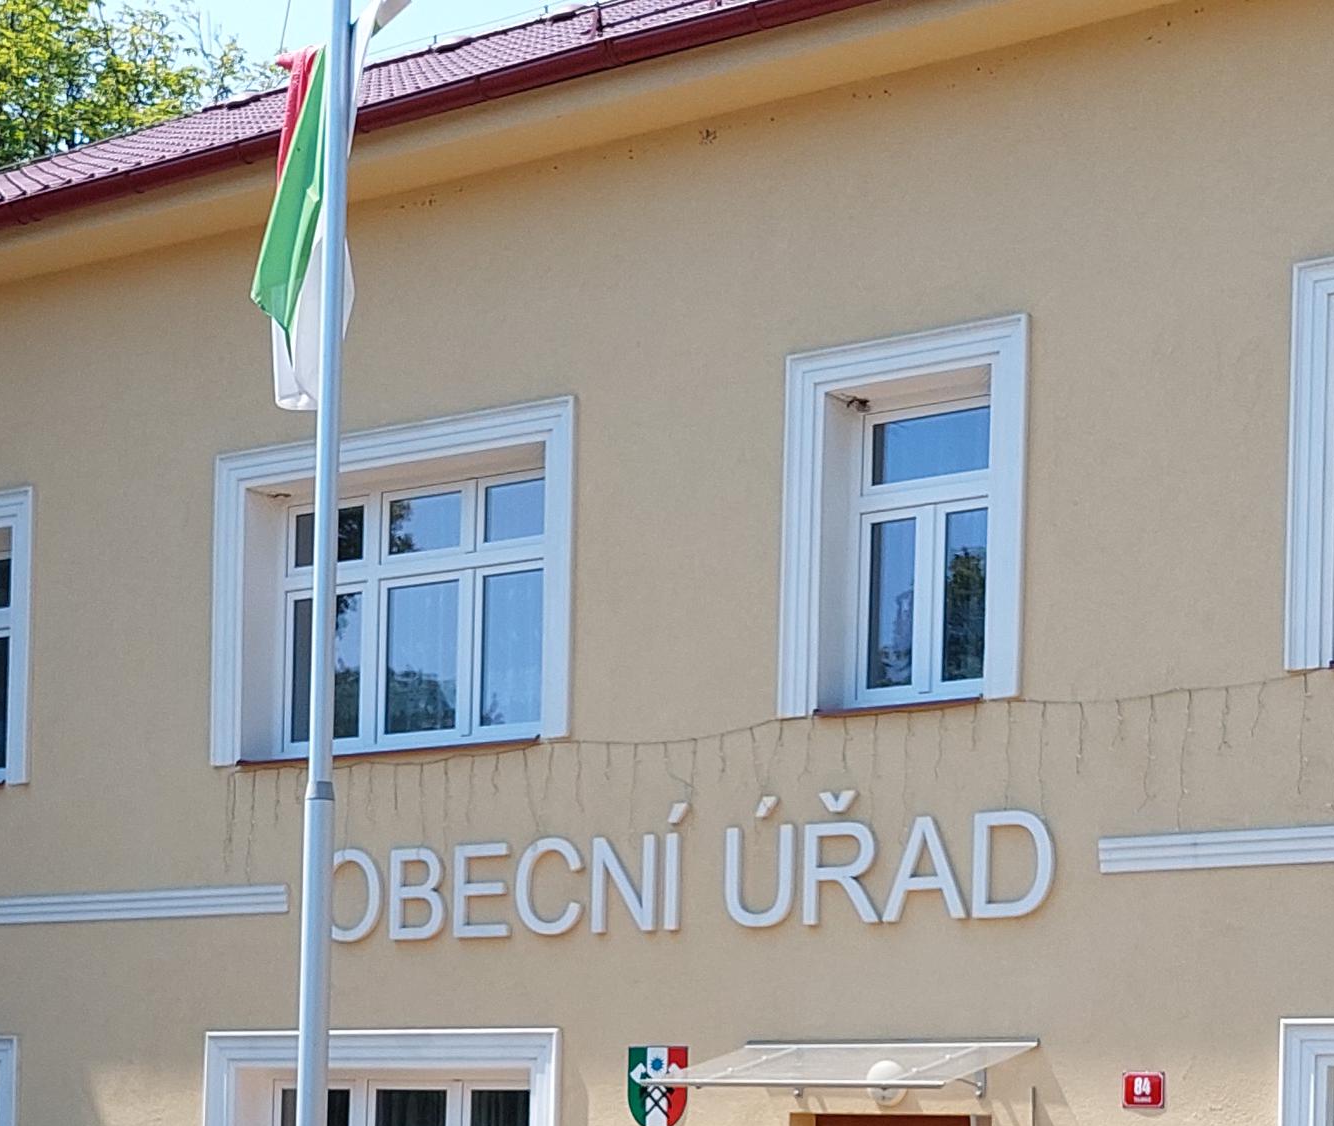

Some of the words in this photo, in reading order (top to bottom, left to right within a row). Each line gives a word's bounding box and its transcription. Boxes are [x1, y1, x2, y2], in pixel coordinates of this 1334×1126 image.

[331, 802, 691, 942] OBECNÍ
[724, 789, 1057, 928] ÚŘAD
[1133, 1076, 1152, 1096] 84
